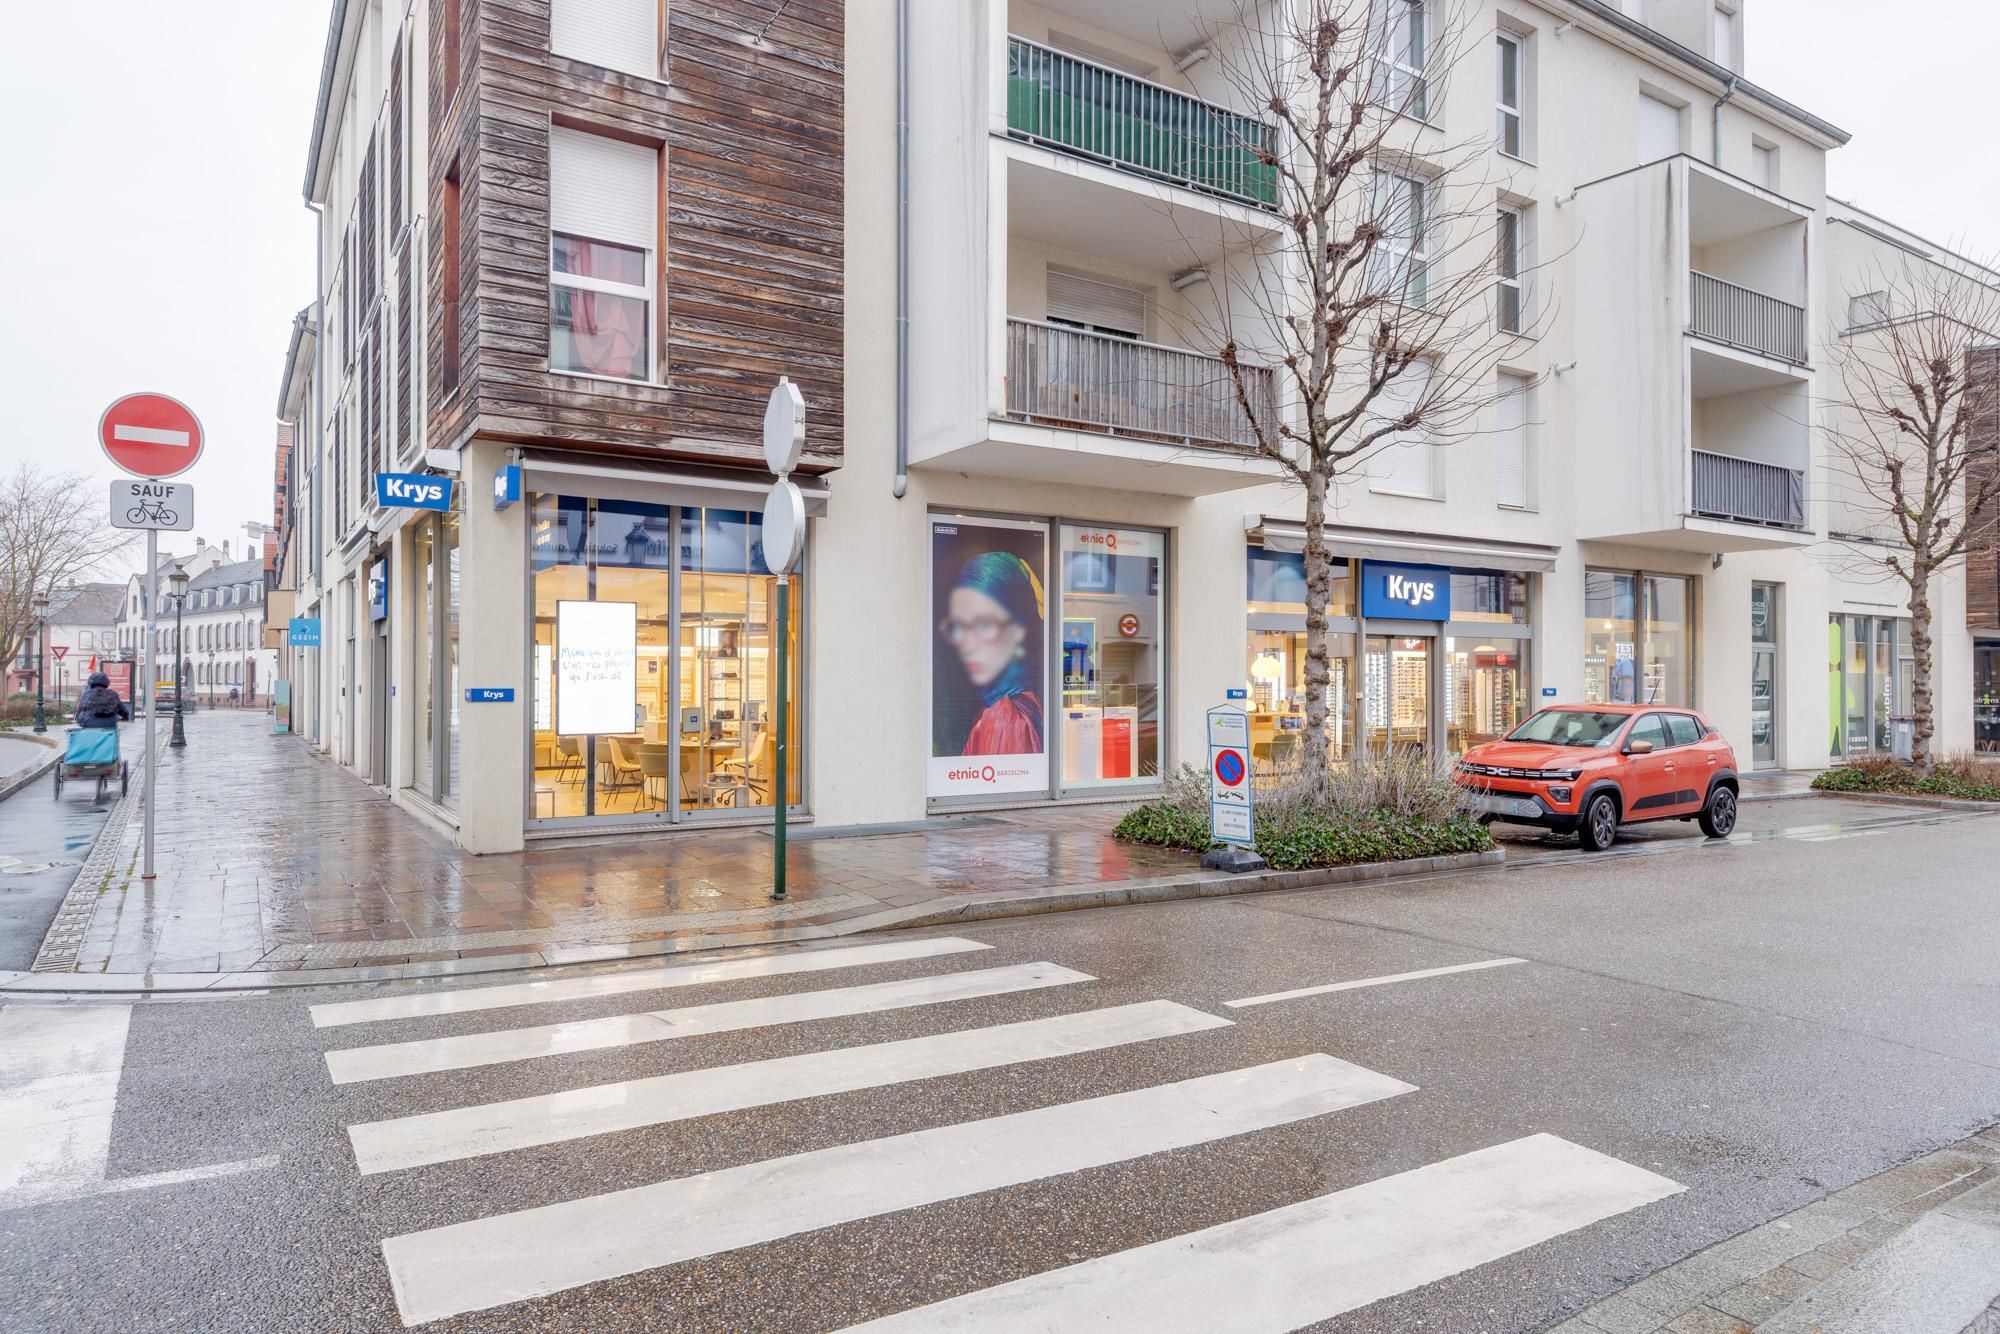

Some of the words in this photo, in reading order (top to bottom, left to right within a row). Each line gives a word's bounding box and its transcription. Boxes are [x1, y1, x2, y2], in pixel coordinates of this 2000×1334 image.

[131, 484, 175, 498] SAUF
[386, 478, 442, 503] Krys
[1080, 533, 1105, 544] etnia
[1389, 574, 1435, 605] Krys
[483, 690, 505, 699] Krys
[948, 766, 980, 780] etnia
[996, 768, 1030, 777] BARCELONA
